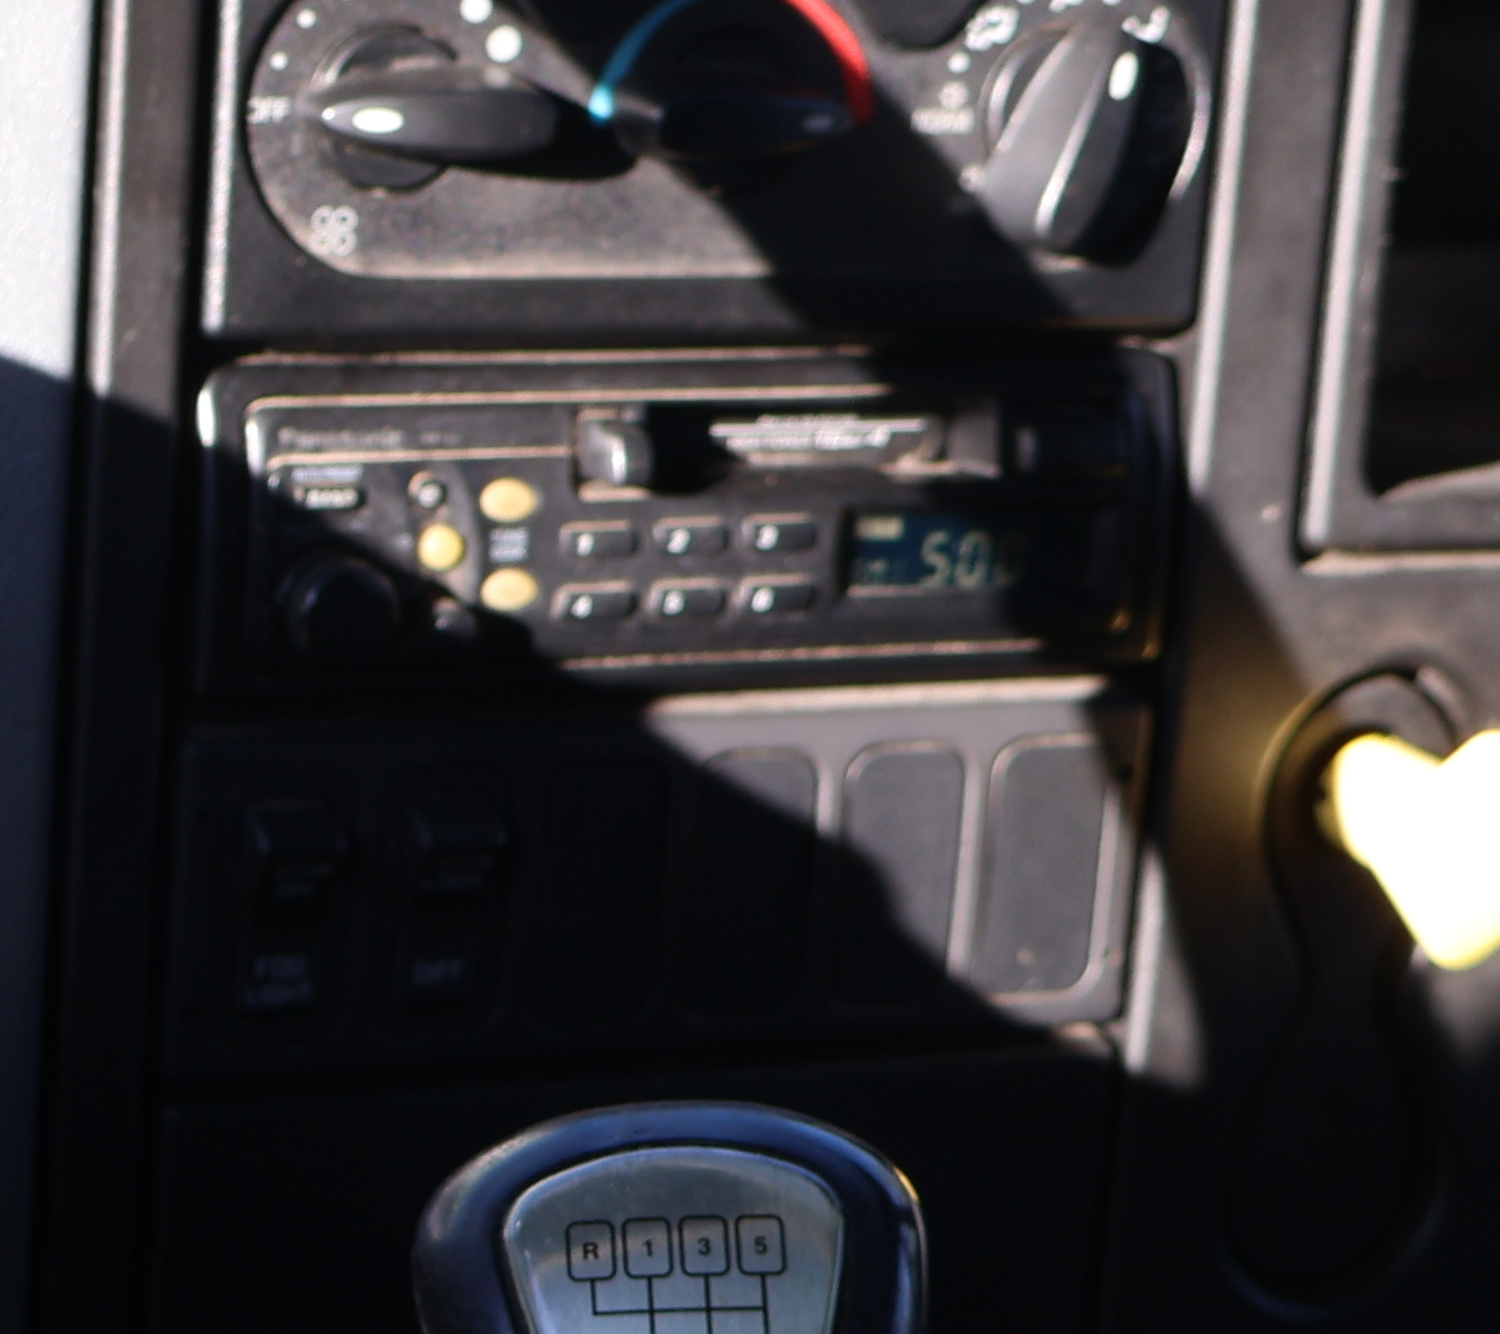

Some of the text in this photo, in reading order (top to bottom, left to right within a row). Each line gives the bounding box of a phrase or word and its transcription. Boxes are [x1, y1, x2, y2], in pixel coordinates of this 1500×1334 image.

[582, 1236, 768, 1260] R 1 3 5
